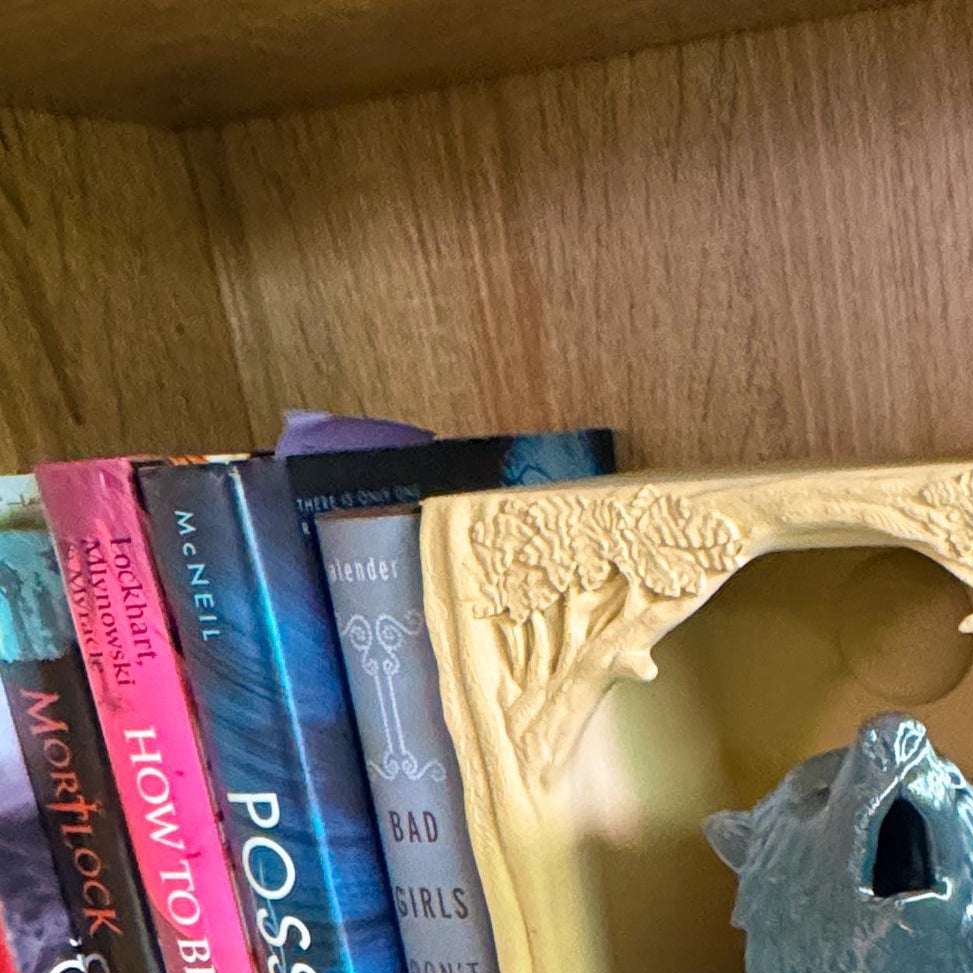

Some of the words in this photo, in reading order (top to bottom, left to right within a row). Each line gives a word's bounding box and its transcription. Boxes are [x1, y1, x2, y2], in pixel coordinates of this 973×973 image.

[81, 539, 135, 686] Mlynowski
[110, 536, 158, 667] Lockhart,
[123, 725, 186, 850] HOW
[159, 858, 201, 926] TO
[389, 810, 439, 843] BAD
[394, 886, 469, 920] GIRLS
